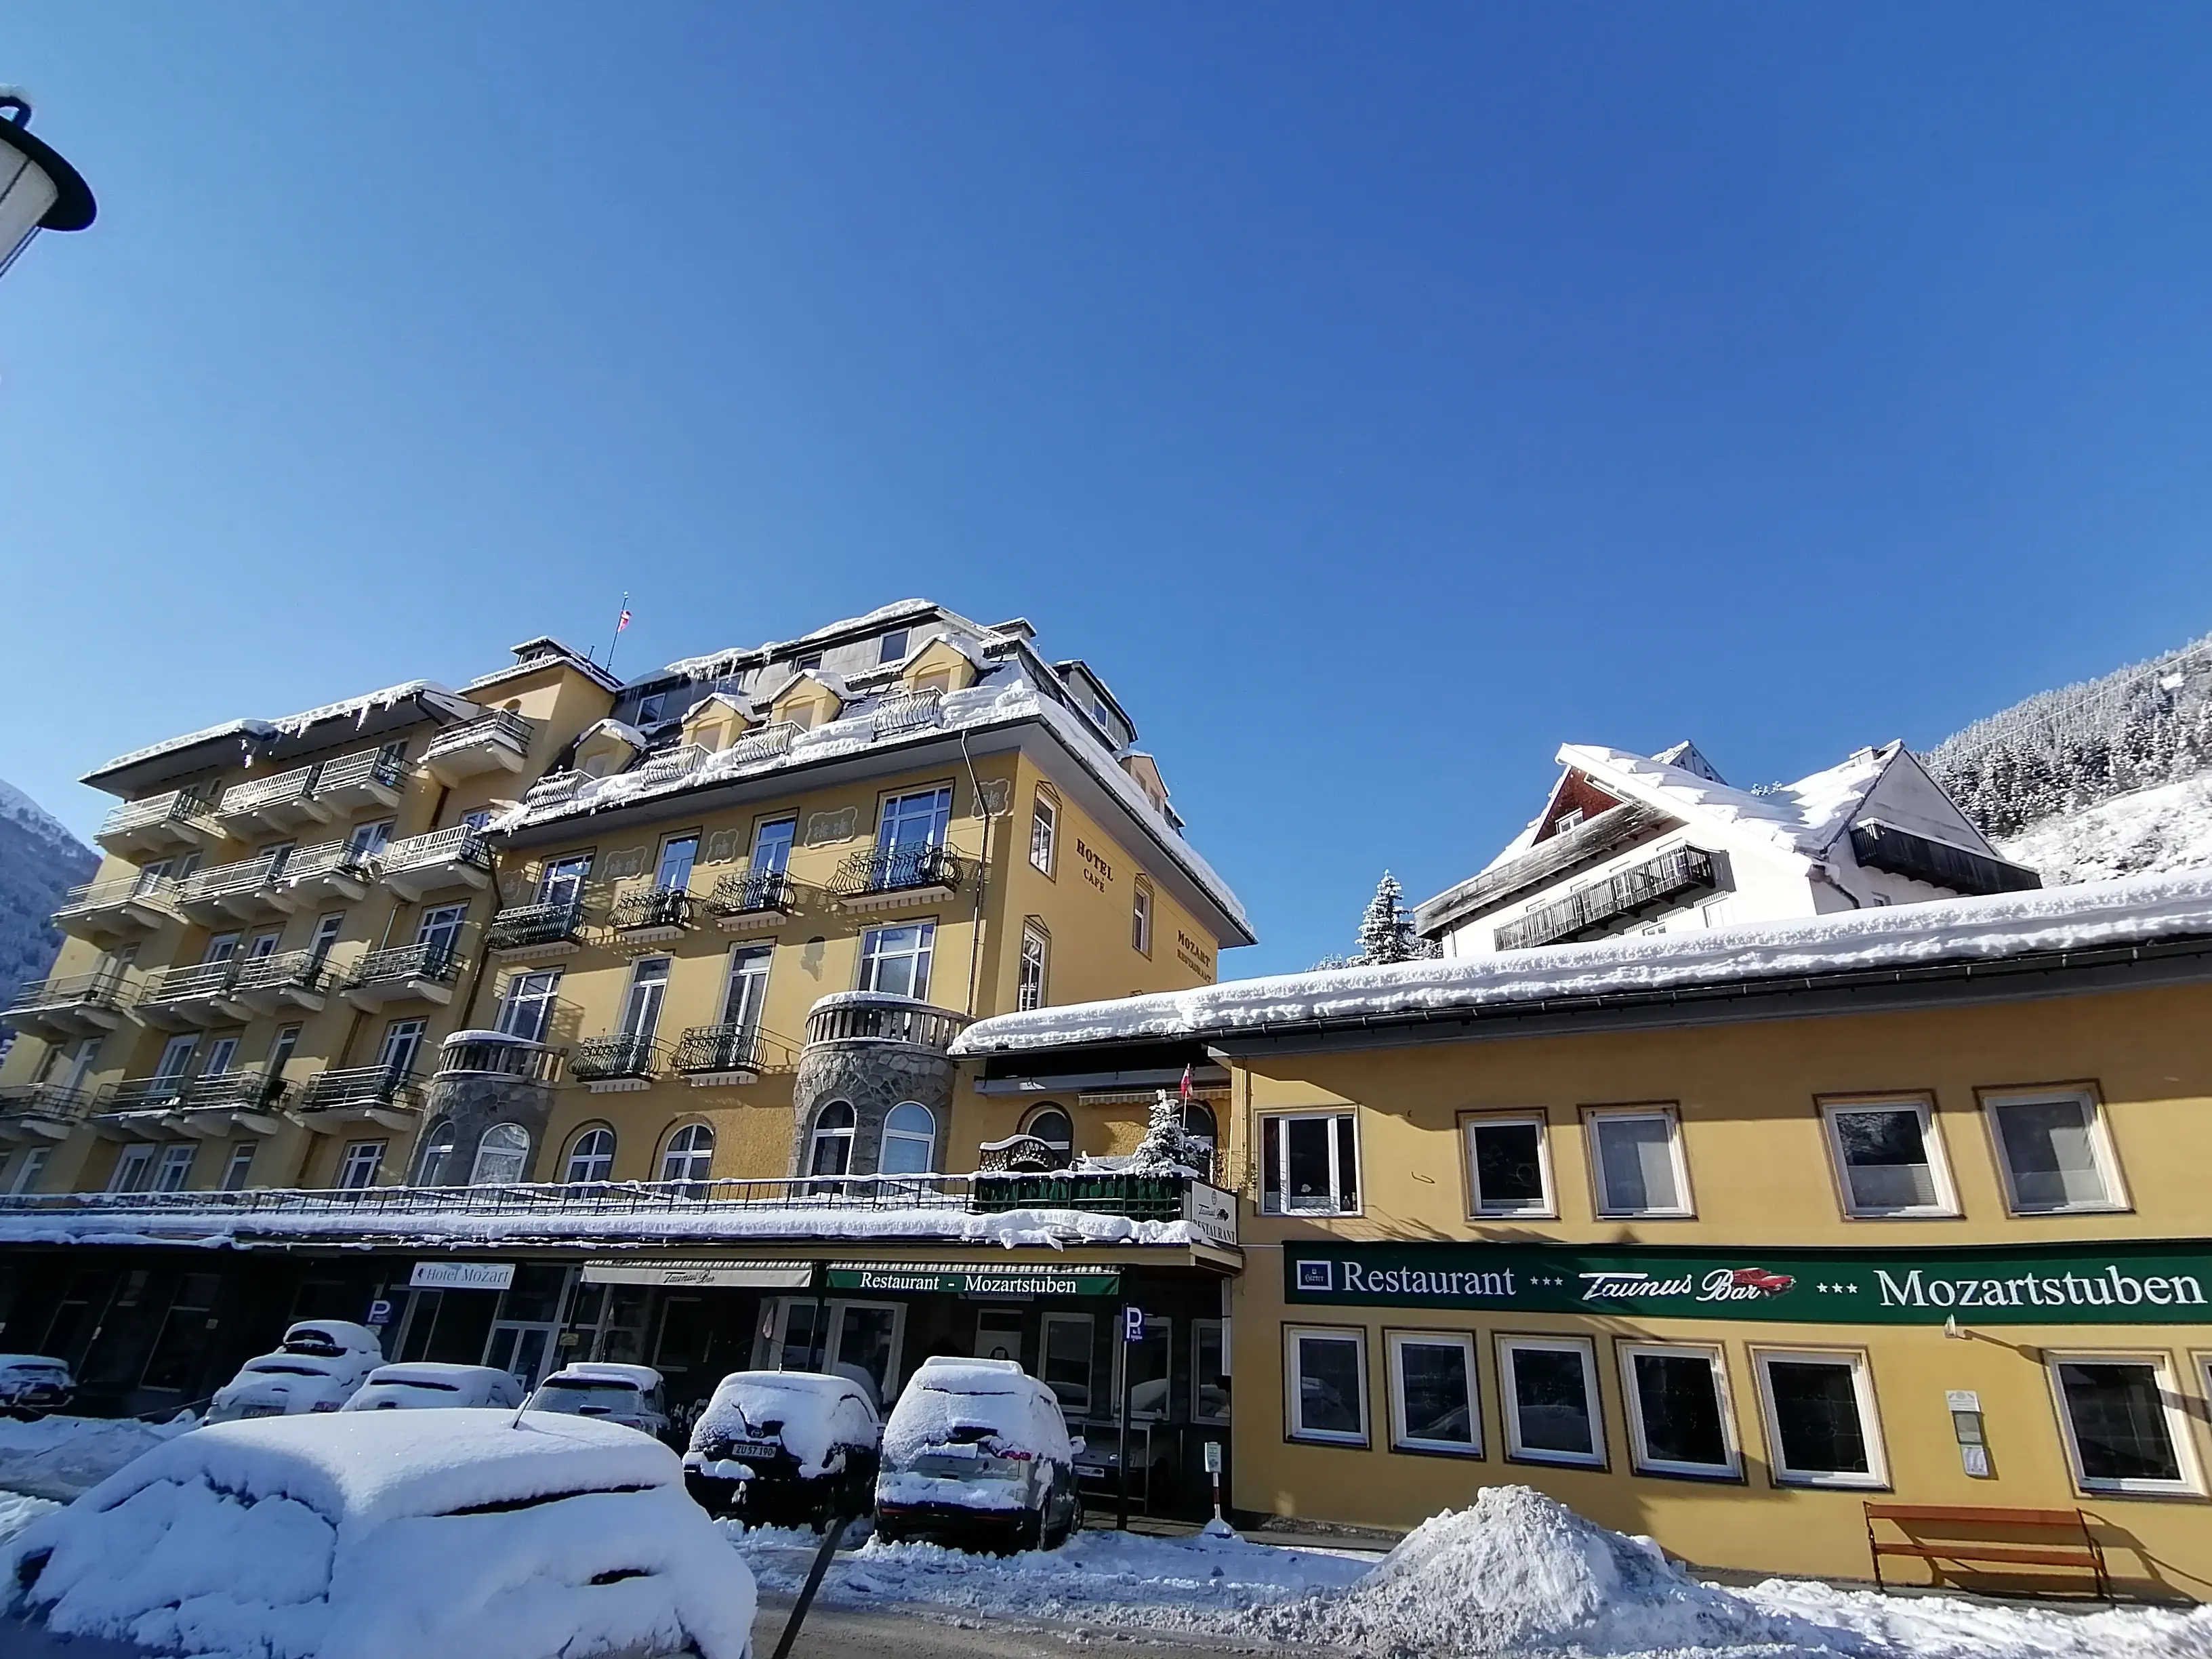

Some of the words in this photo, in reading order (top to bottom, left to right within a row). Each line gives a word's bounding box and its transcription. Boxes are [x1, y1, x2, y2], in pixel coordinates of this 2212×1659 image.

[1076, 838, 1113, 882] HOTEL
[1084, 868, 1105, 893] CAFÉ
[1178, 929, 1211, 968] MOZART
[426, 1268, 459, 1282] Hotel
[461, 1268, 509, 1283] Mozart
[859, 1272, 940, 1290] Restaurant
[963, 1275, 1077, 1293] Mozartstuben
[1340, 1261, 1517, 1295] Restaurant
[1578, 1272, 1693, 1300] Taunus
[1696, 1268, 1762, 1301] Bar
[1872, 1265, 2209, 1307] Mozartstuben
[367, 1299, 391, 1323] P
[1126, 1307, 1143, 1339] P
[736, 1445, 747, 1454] ZU
